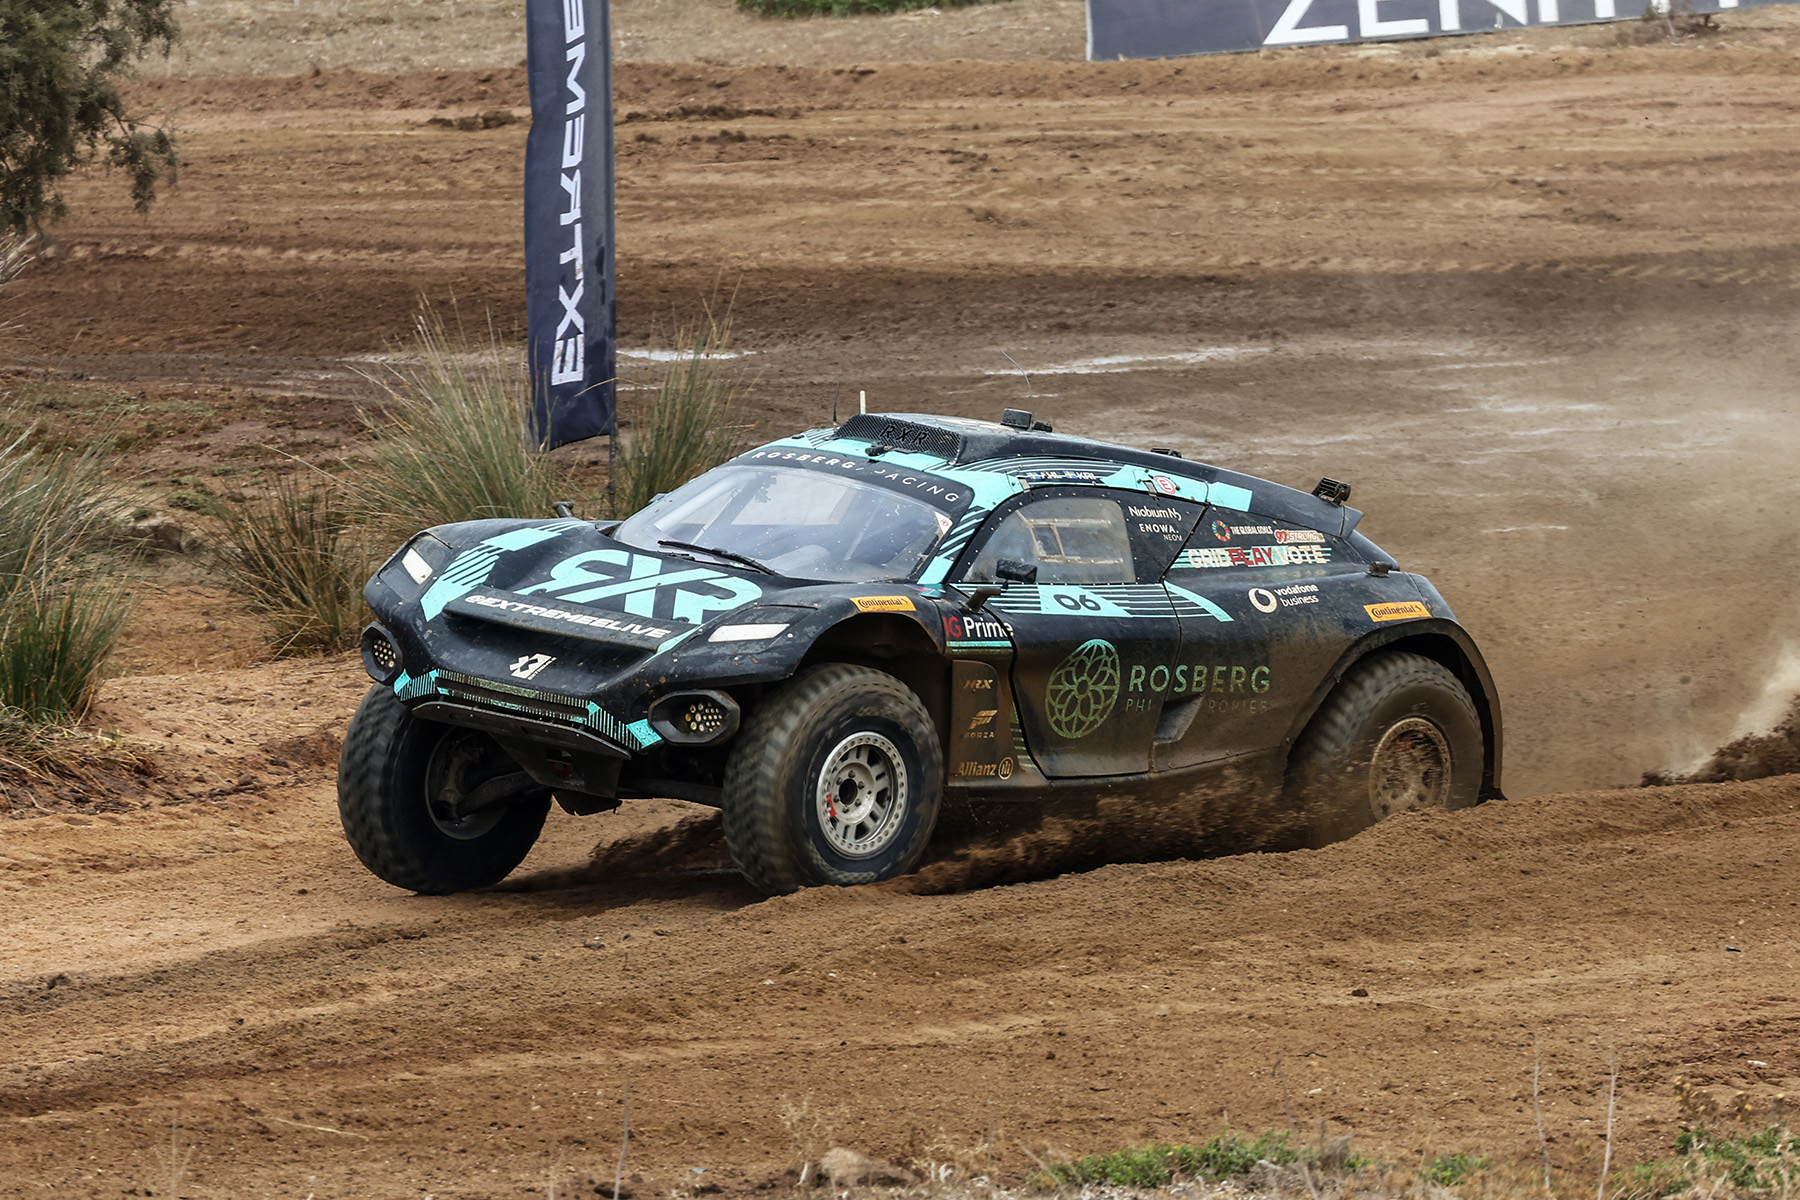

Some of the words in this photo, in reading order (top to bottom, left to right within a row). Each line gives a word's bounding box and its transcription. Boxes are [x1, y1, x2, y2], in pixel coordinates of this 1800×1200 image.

[880, 425, 928, 444] RXR
[751, 451, 856, 469] ROSBERG
[1274, 584, 1319, 596] vodafone
[858, 598, 903, 608] Continental
[1053, 594, 1101, 611] 06
[1280, 595, 1319, 607] business
[465, 595, 672, 639] @EXTREMEELIVE
[1371, 605, 1416, 618] Continental
[943, 616, 962, 638] IG
[963, 616, 1014, 638] Prime
[1128, 664, 1271, 693] ROSBERG
[964, 731, 995, 739] FORZA
[957, 762, 997, 776] Allianz
